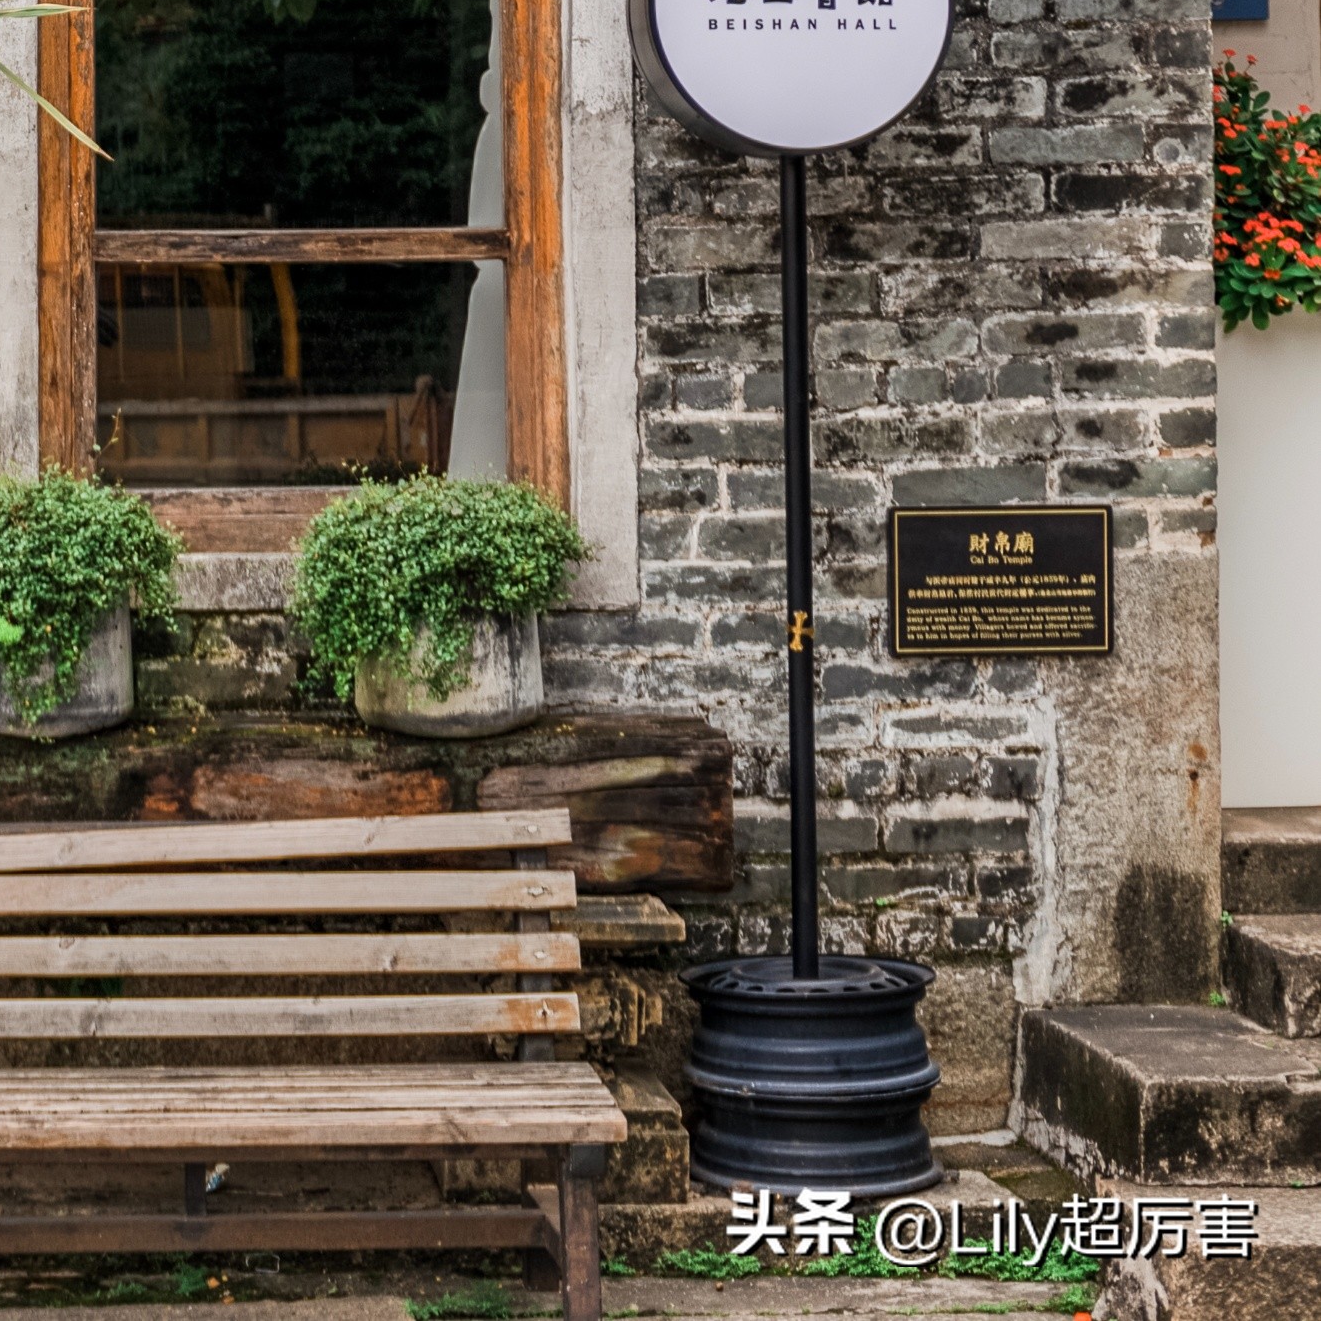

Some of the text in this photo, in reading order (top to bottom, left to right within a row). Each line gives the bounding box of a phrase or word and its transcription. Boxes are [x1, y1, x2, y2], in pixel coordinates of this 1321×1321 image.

[708, 18, 897, 31] BEISHAN HALL
[969, 530, 1034, 555] 財帛廟
[970, 555, 1033, 566] Cai Bo Temple
